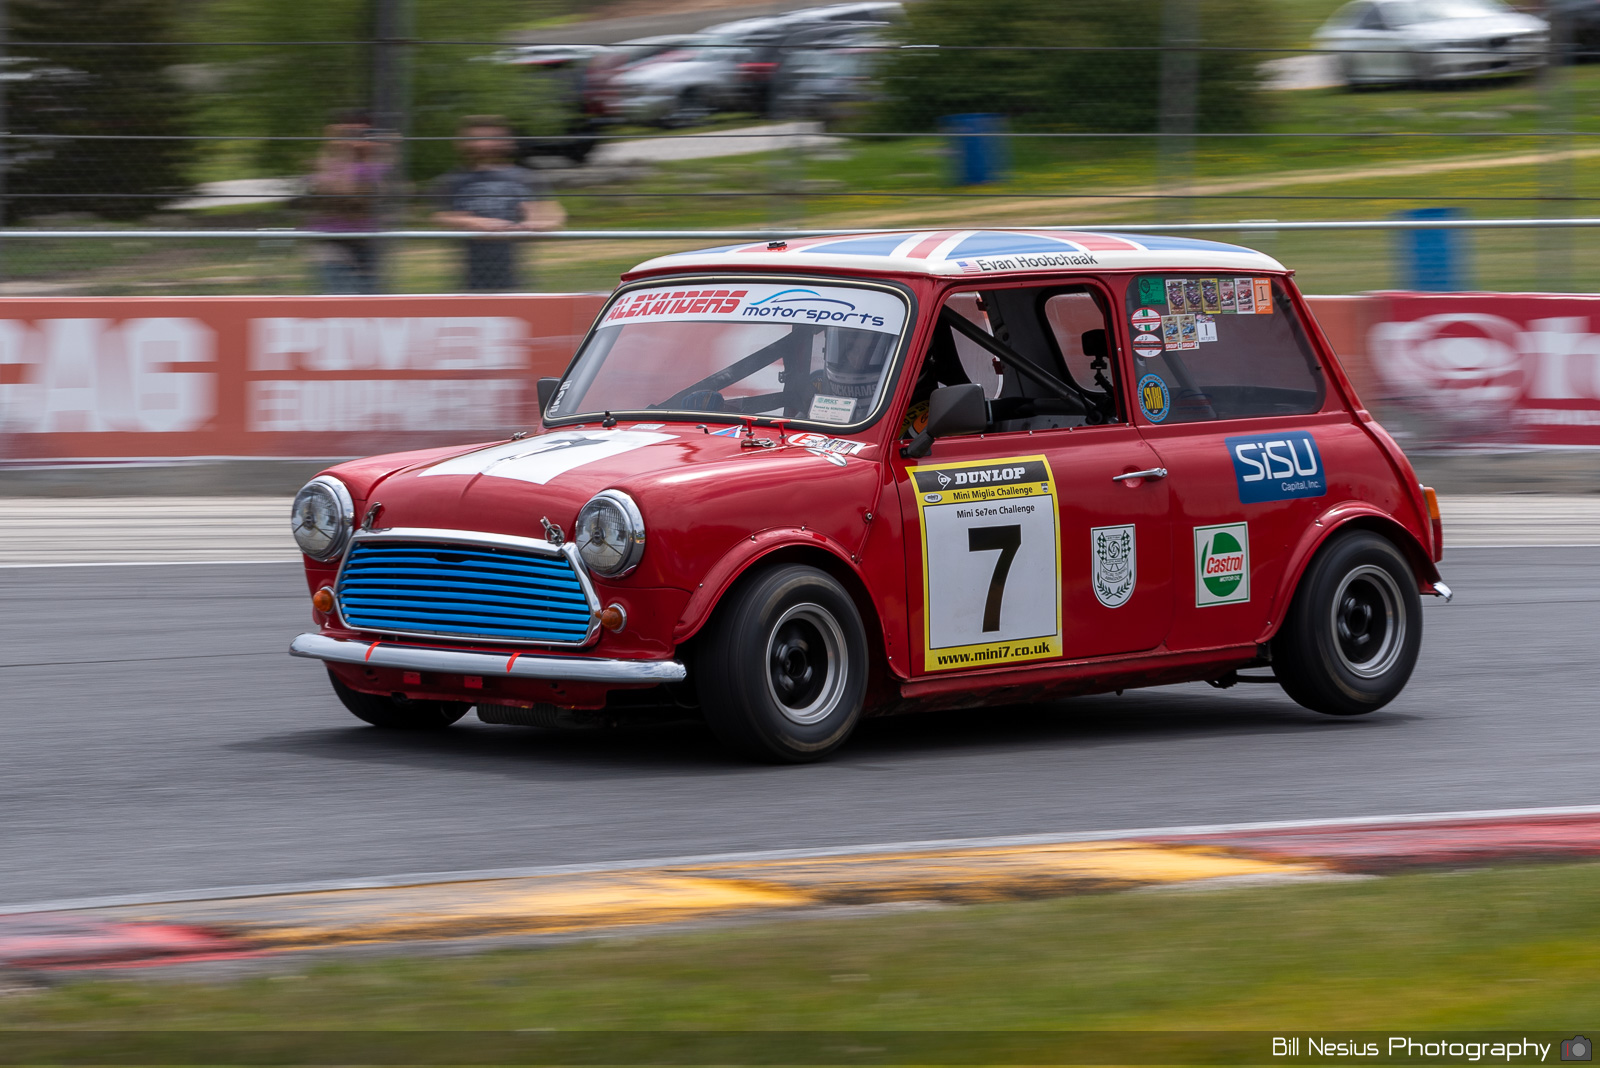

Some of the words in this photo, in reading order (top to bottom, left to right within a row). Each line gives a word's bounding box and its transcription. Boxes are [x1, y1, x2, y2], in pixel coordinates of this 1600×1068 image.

[976, 259, 1015, 271] Evan
[1015, 253, 1099, 268] Hoobchaak
[605, 290, 748, 322] ALEXANDERS
[742, 305, 884, 327] motorsports
[829, 382, 877, 397] UCKHAMS
[955, 466, 1026, 485] DUNLOP
[953, 491, 970, 501] Mini
[972, 489, 996, 500] Miglia
[996, 485, 1033, 497] Challenge
[1281, 480, 1308, 492] Capital,
[1308, 479, 1321, 489] Inc.
[956, 509, 974, 518] Mini
[975, 507, 997, 518] Se7en
[999, 503, 1035, 516] Challenge
[1206, 554, 1244, 574] Castrol
[968, 524, 1021, 633] 7
[937, 641, 1051, 665] www.mini7.co.uk
